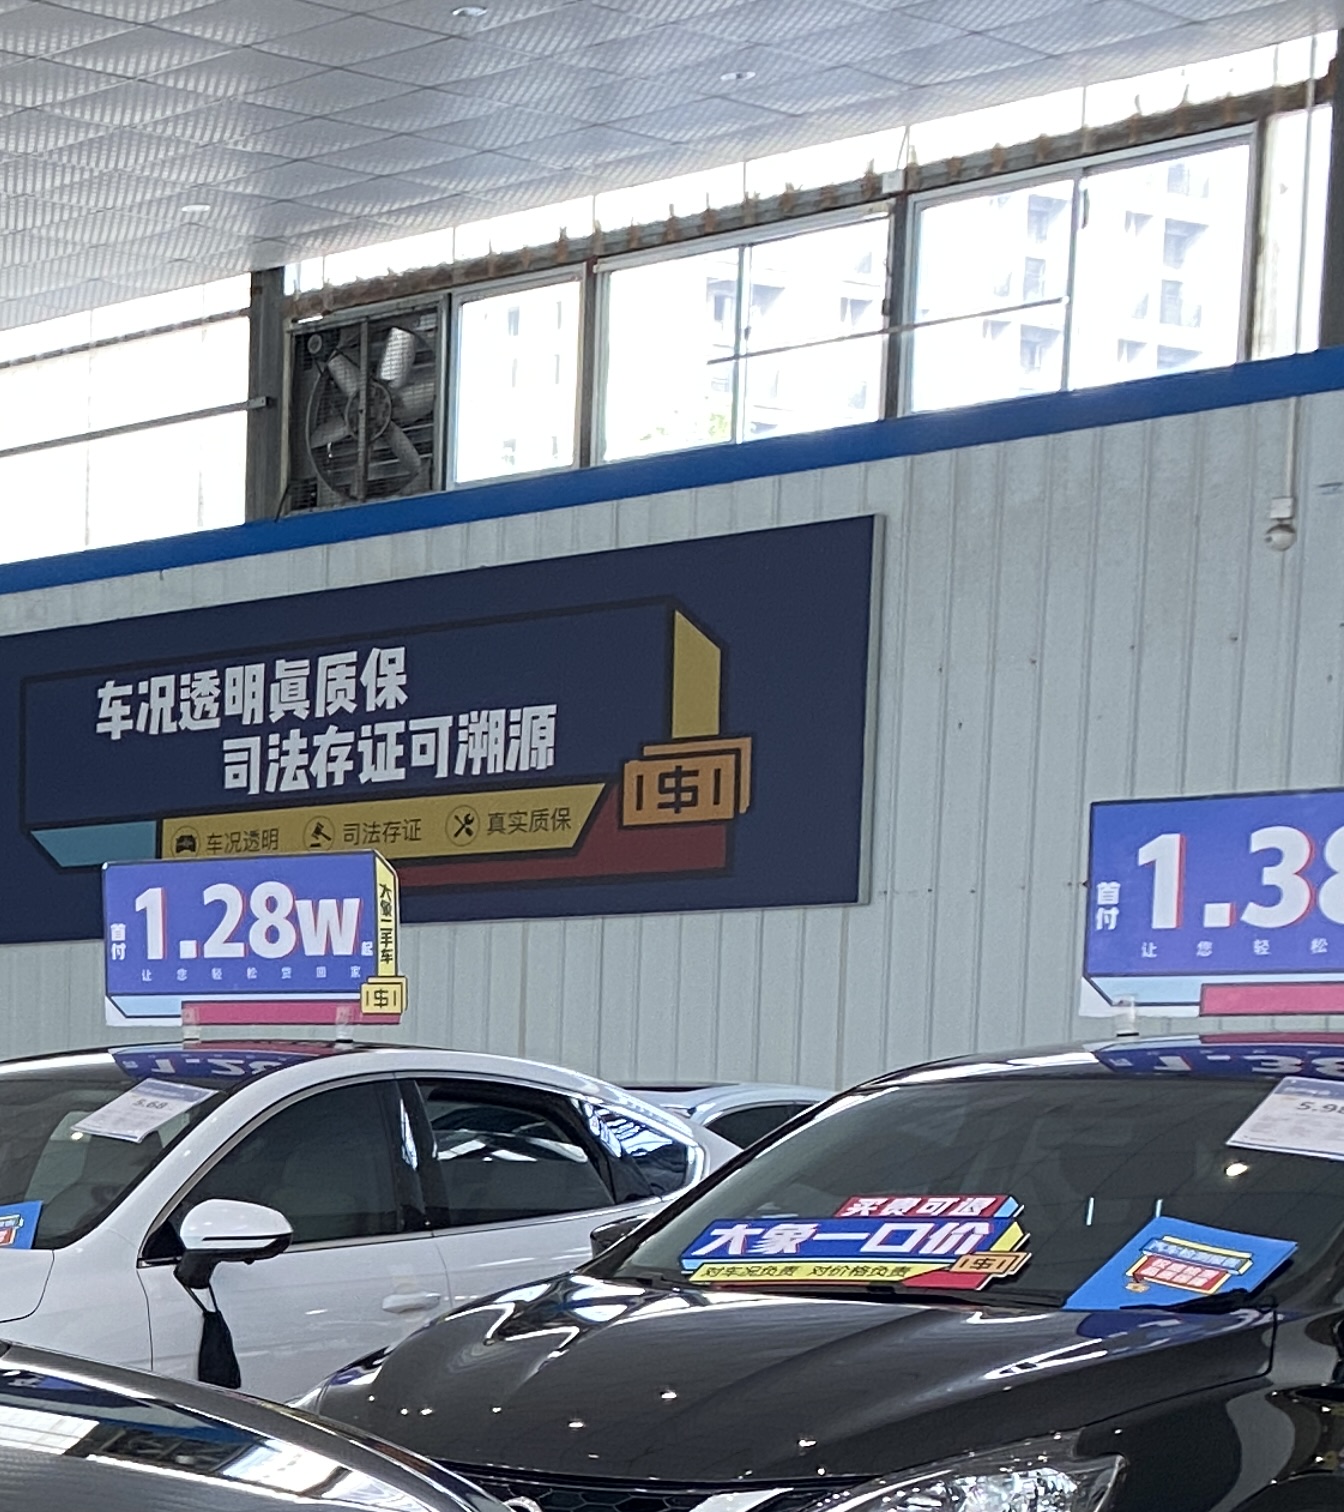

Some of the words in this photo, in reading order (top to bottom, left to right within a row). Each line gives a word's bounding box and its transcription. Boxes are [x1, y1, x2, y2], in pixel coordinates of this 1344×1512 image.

[222, 703, 558, 796] 司法存证可溯源
[342, 817, 422, 846] 司法存证
[486, 806, 573, 836] 真实质保
[206, 828, 280, 853] 车况透明
[1095, 881, 1121, 931] 首付
[1141, 938, 1328, 958] 让您轻松
[691, 1222, 994, 1256] 大象一口价
[701, 1266, 799, 1278] 对车况负责
[807, 1265, 912, 1278] 对价格负责
